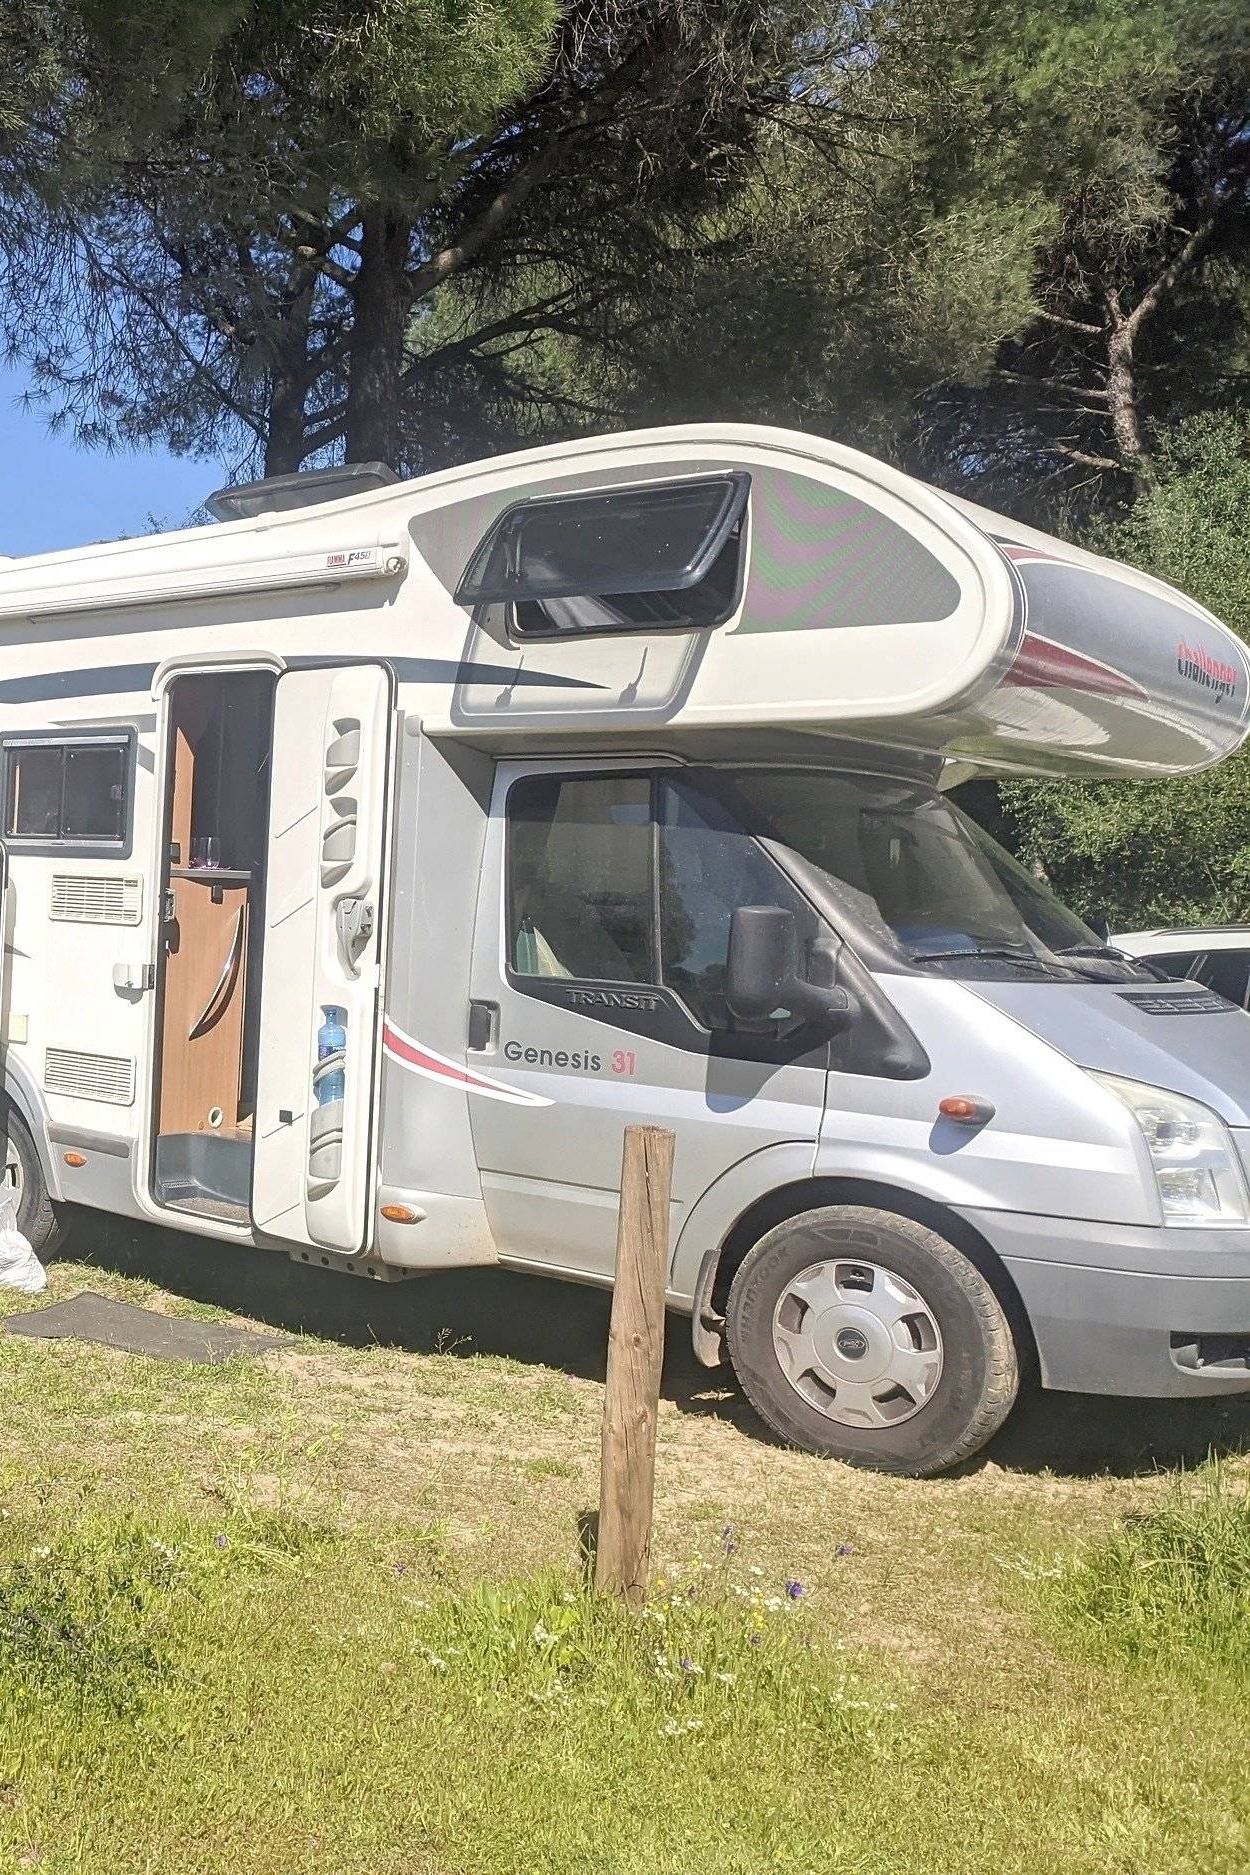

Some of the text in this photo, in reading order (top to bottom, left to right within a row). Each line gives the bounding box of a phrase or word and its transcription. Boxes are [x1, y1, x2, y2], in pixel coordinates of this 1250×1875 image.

[565, 988, 659, 1012] TRANSIT
[503, 1040, 638, 1076] Genesis 31
